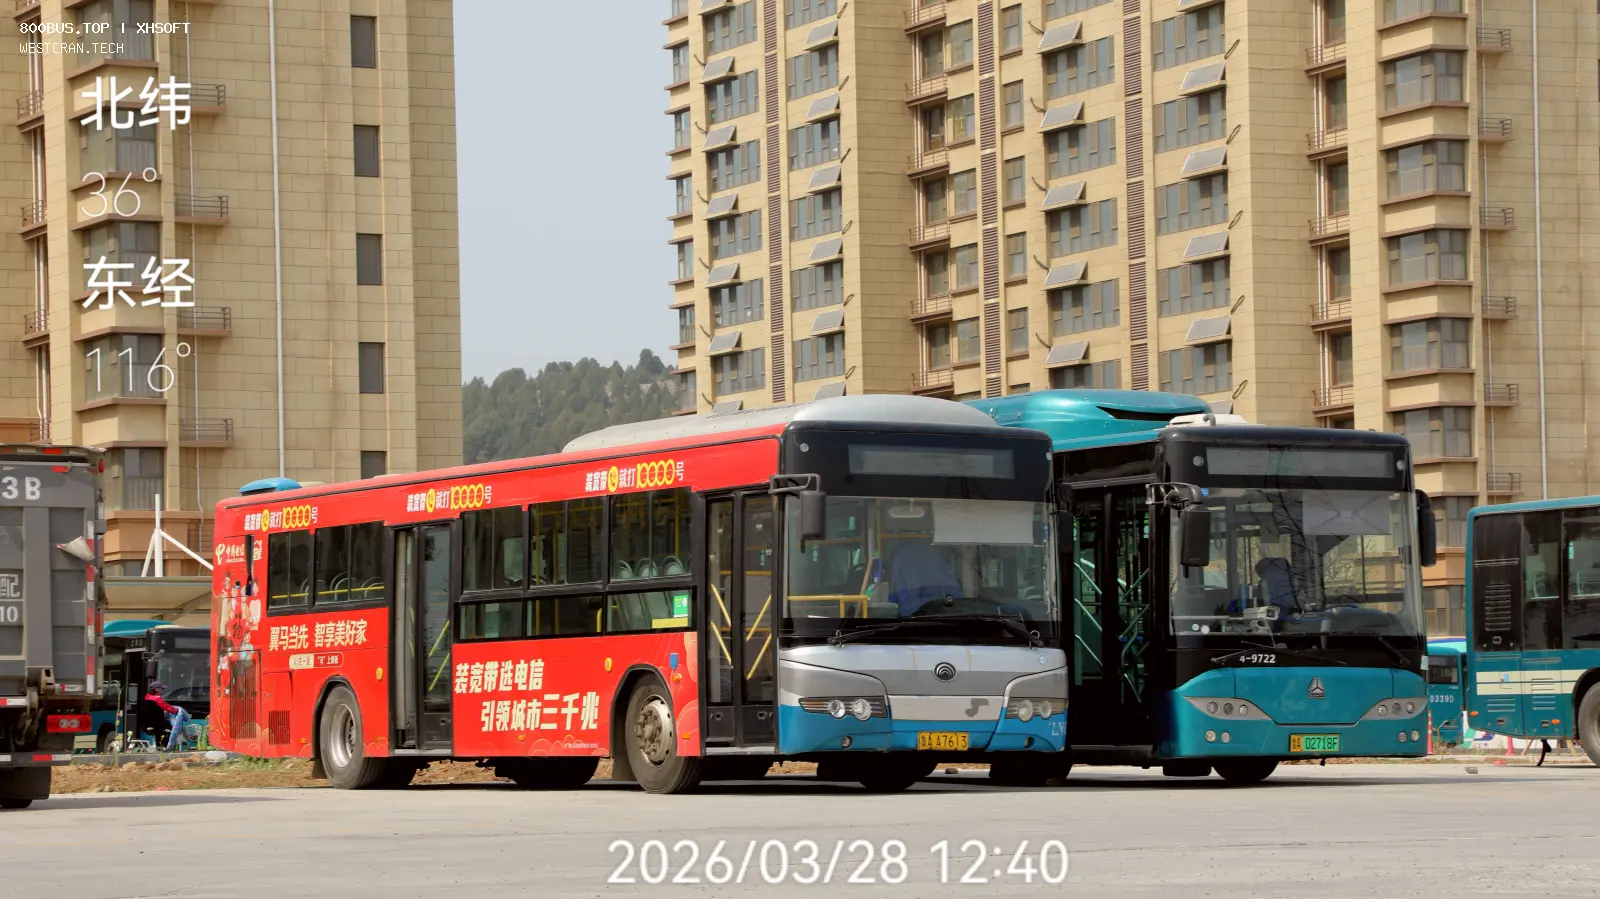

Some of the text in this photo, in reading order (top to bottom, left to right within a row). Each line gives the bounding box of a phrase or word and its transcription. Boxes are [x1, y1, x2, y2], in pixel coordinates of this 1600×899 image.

[268, 623, 310, 652] 翼马当先
[314, 618, 368, 648] 智享美好家
[454, 658, 545, 694] 装宽带选电信
[1239, 653, 1276, 664] 4-9722
[480, 691, 600, 732] 引领城市三千兆
